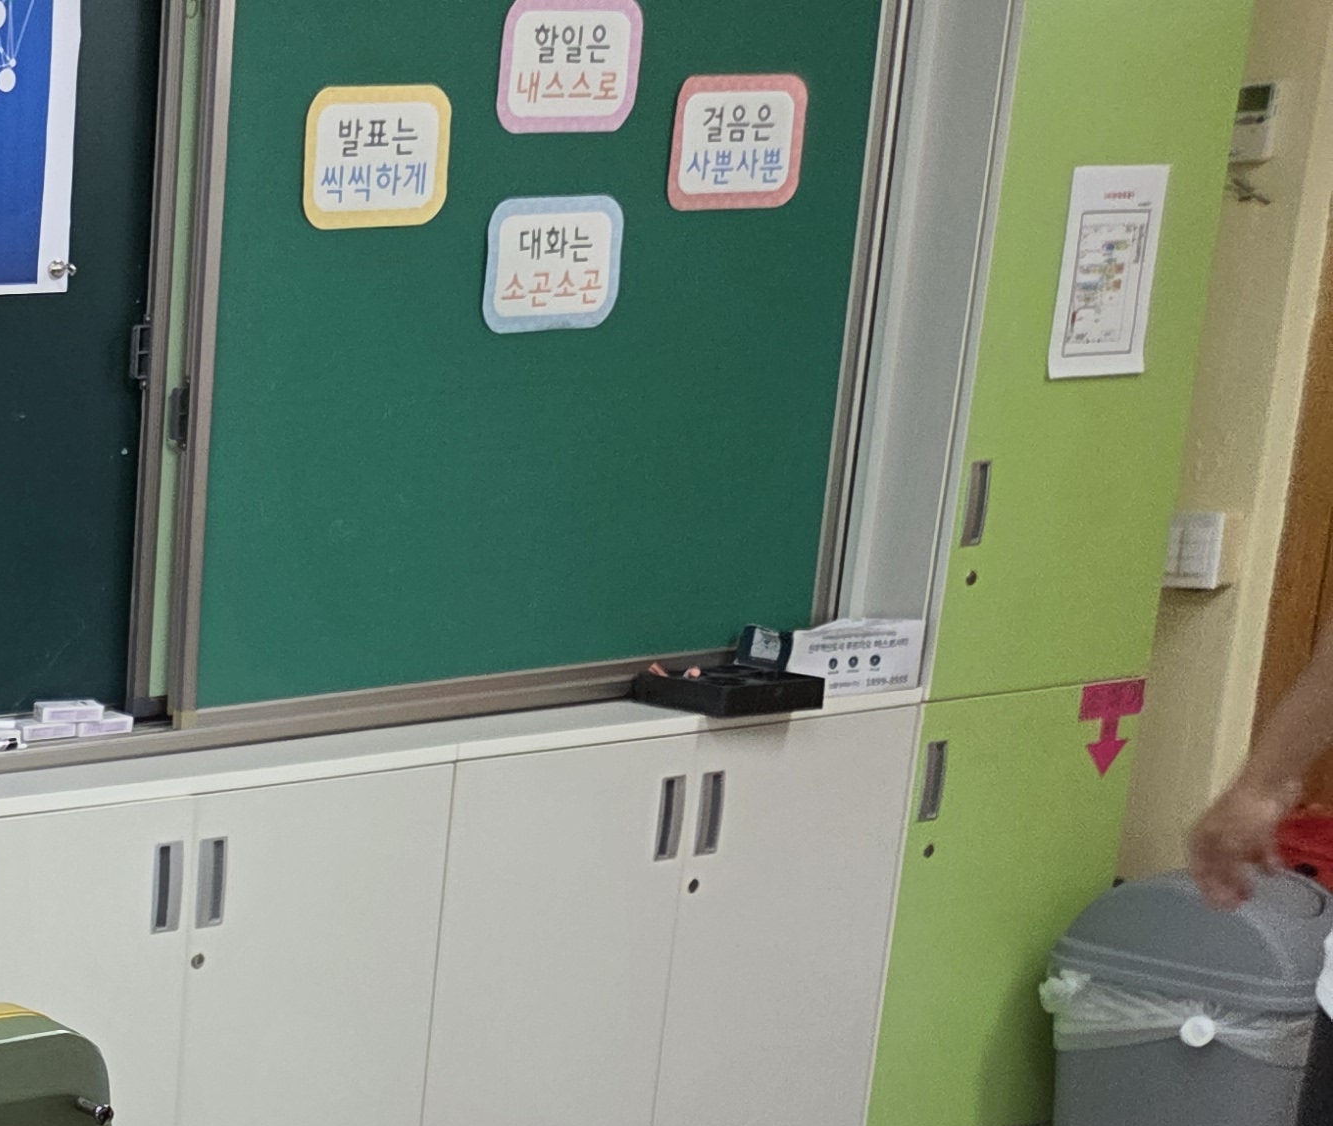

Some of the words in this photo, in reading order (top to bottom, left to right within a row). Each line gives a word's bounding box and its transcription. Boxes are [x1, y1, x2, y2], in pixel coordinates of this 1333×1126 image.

[534, 24, 611, 64] 할일은
[517, 70, 619, 104] 내스스로
[338, 116, 419, 158] 발표는
[702, 104, 775, 143] 걸음은
[320, 161, 428, 204] 씩씩하게
[686, 148, 783, 185] 사뿐사뿐
[519, 226, 593, 263] 대화는
[500, 269, 603, 308] 소곤소곤
